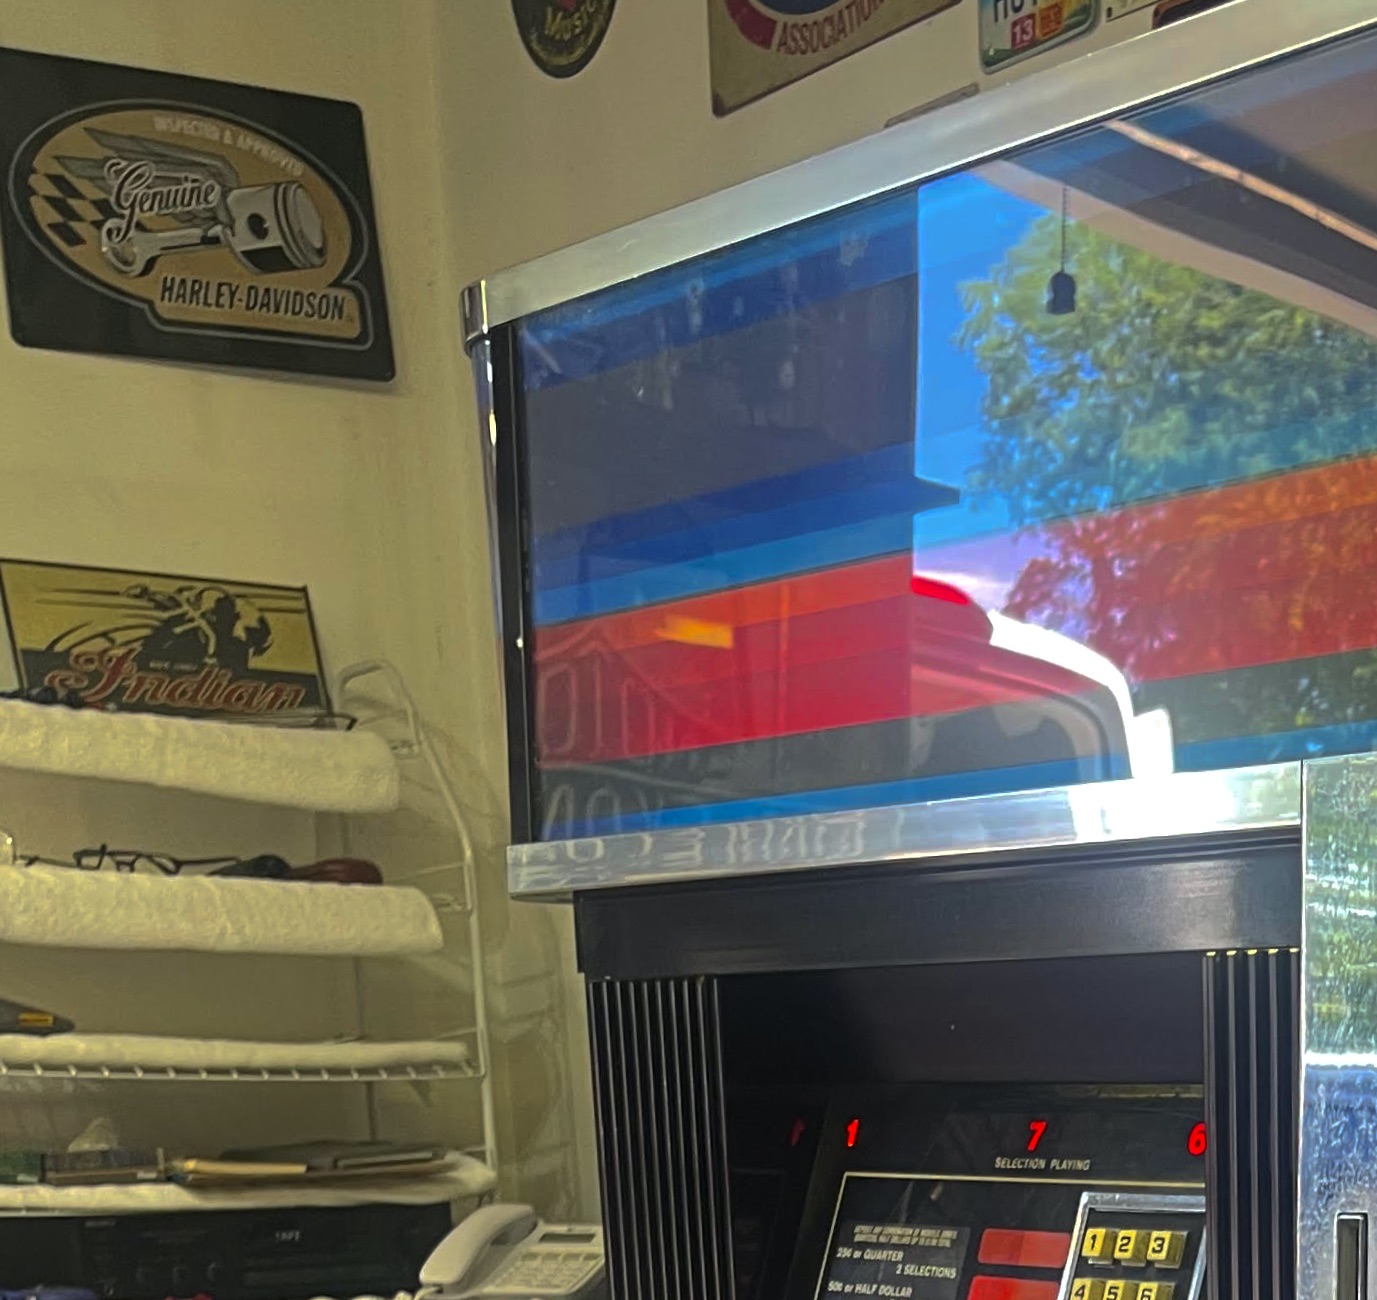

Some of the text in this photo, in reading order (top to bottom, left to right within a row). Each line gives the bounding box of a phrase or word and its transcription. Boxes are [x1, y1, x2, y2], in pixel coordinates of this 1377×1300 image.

[1012, 20, 1034, 44] 13
[103, 157, 219, 243] Genuine
[160, 276, 346, 320] HARLEY-DAVIDSON
[45, 646, 305, 712] Indian
[846, 1119, 1207, 1155] 1 7 6
[995, 1157, 1091, 1171] SELECTION PLAYING
[1090, 1234, 1165, 1253] 1 2 3
[863, 1249, 904, 1262] QUARTER
[904, 1264, 957, 1279] SELECTIONS
[855, 1283, 877, 1294] HALF
[878, 1285, 913, 1298] DOLLAR
[1074, 1284, 1086, 1298] 4
